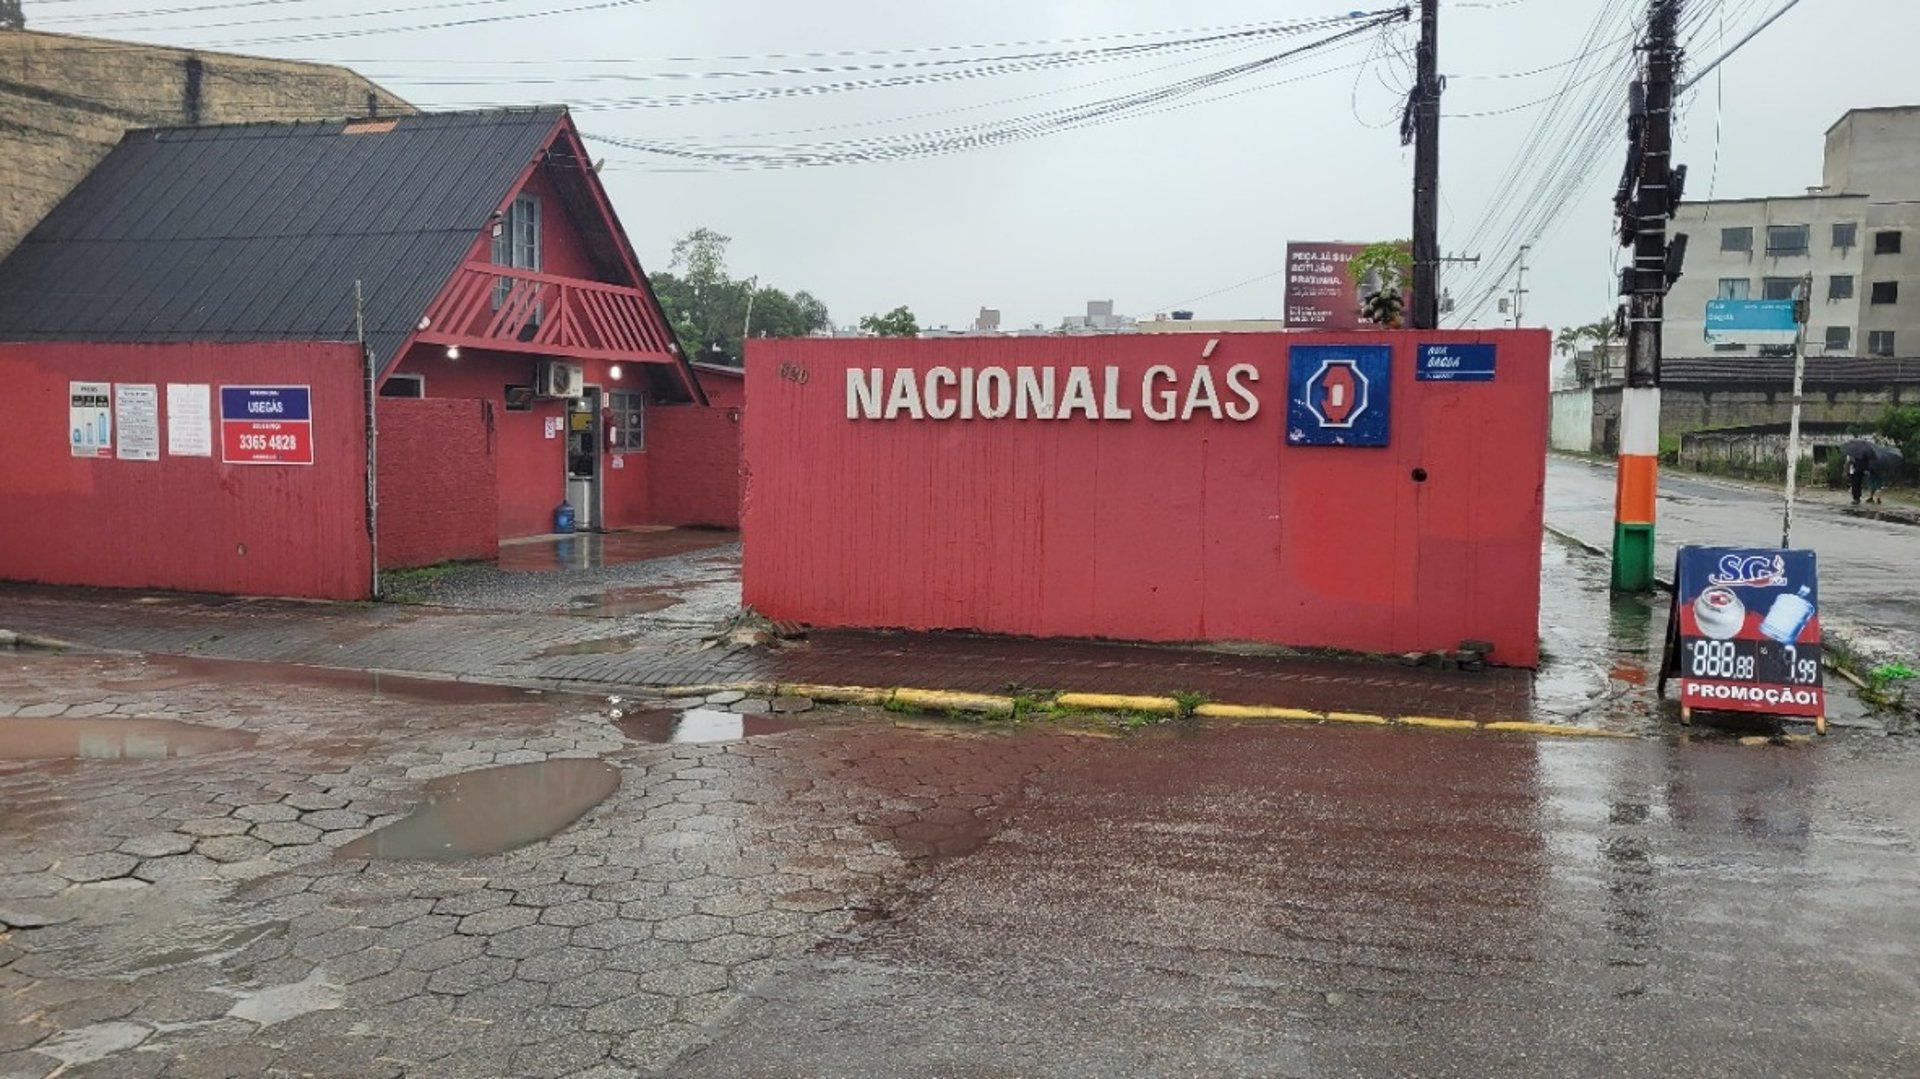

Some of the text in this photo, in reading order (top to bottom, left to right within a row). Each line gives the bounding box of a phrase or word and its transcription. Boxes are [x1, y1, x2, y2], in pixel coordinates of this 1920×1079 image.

[846, 339, 1260, 421] NACIONAL GÁS
[239, 434, 296, 451] 3365 4828
[1718, 554, 1772, 581] SG
